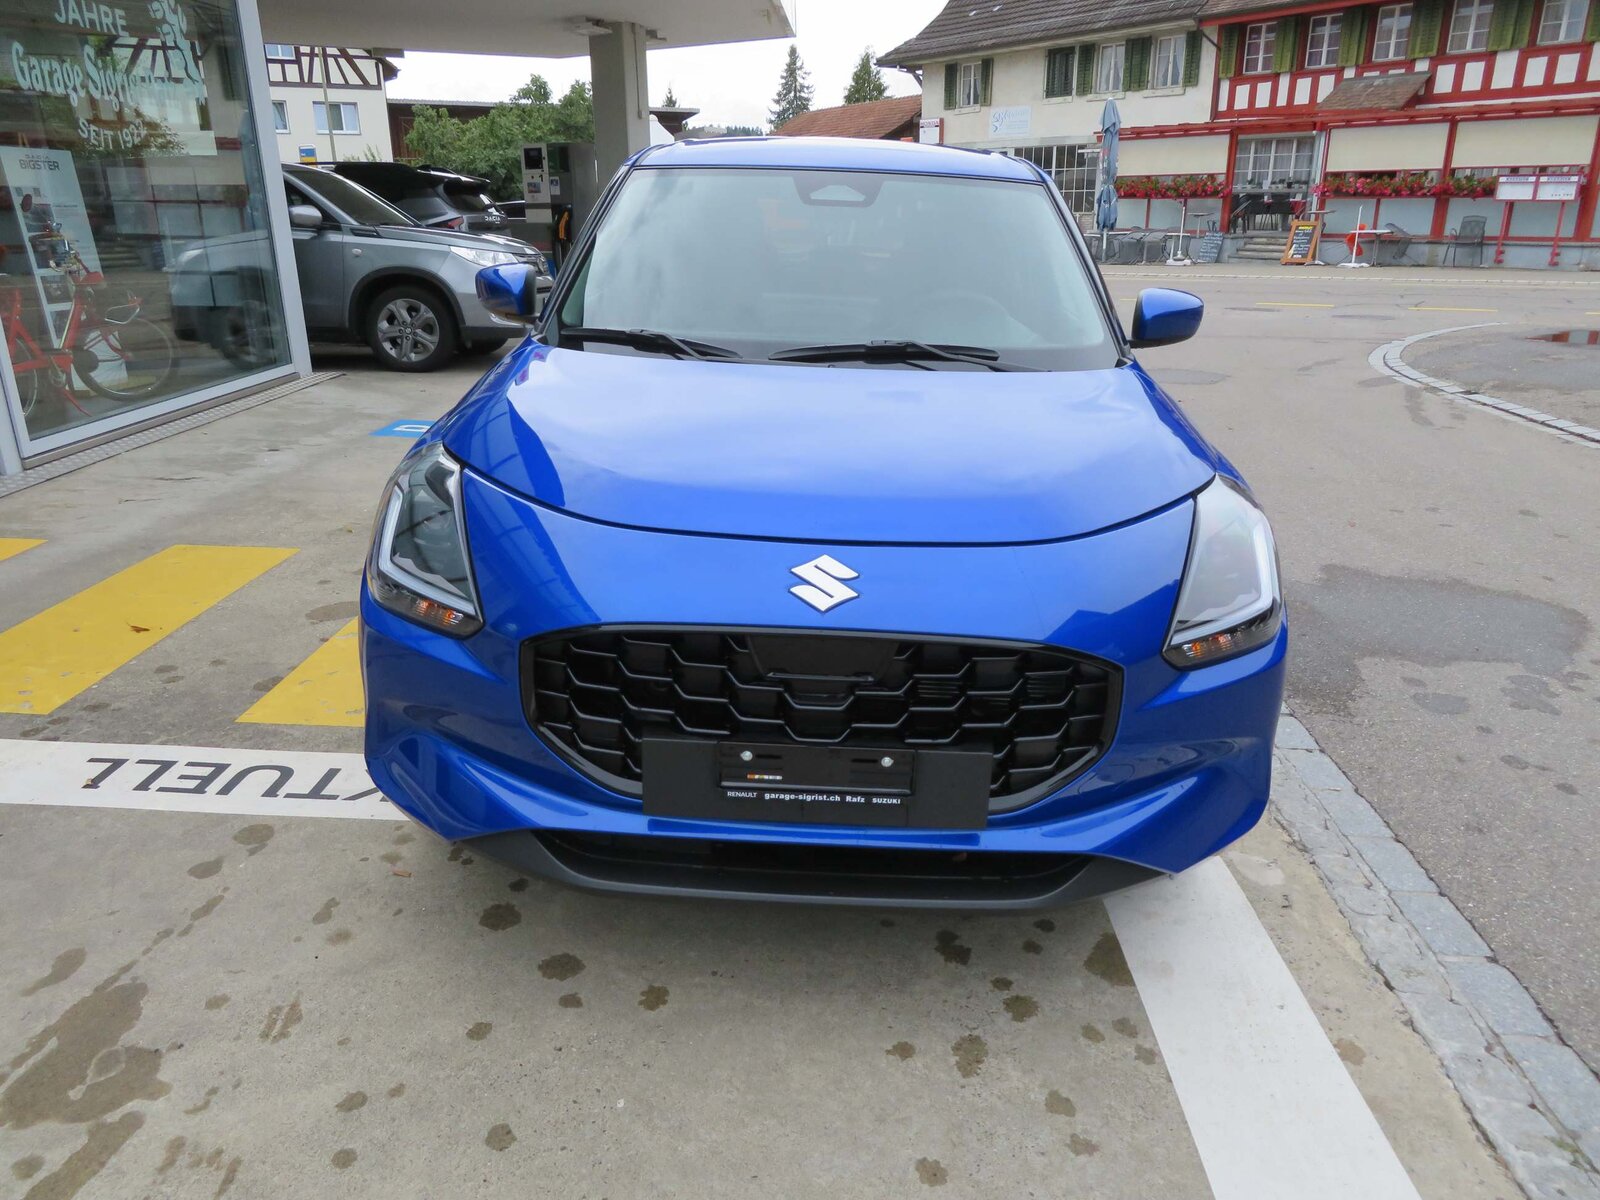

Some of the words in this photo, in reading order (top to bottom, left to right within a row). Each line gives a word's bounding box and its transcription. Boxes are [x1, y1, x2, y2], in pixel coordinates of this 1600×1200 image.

[55, 0, 129, 37] JAHRE
[12, 40, 86, 108] Garage
[78, 117, 113, 149] SEIT
[19, 159, 60, 171] BIGSTER
[764, 793, 841, 802] garage-sigrist.ch
[845, 795, 865, 803] Rafz
